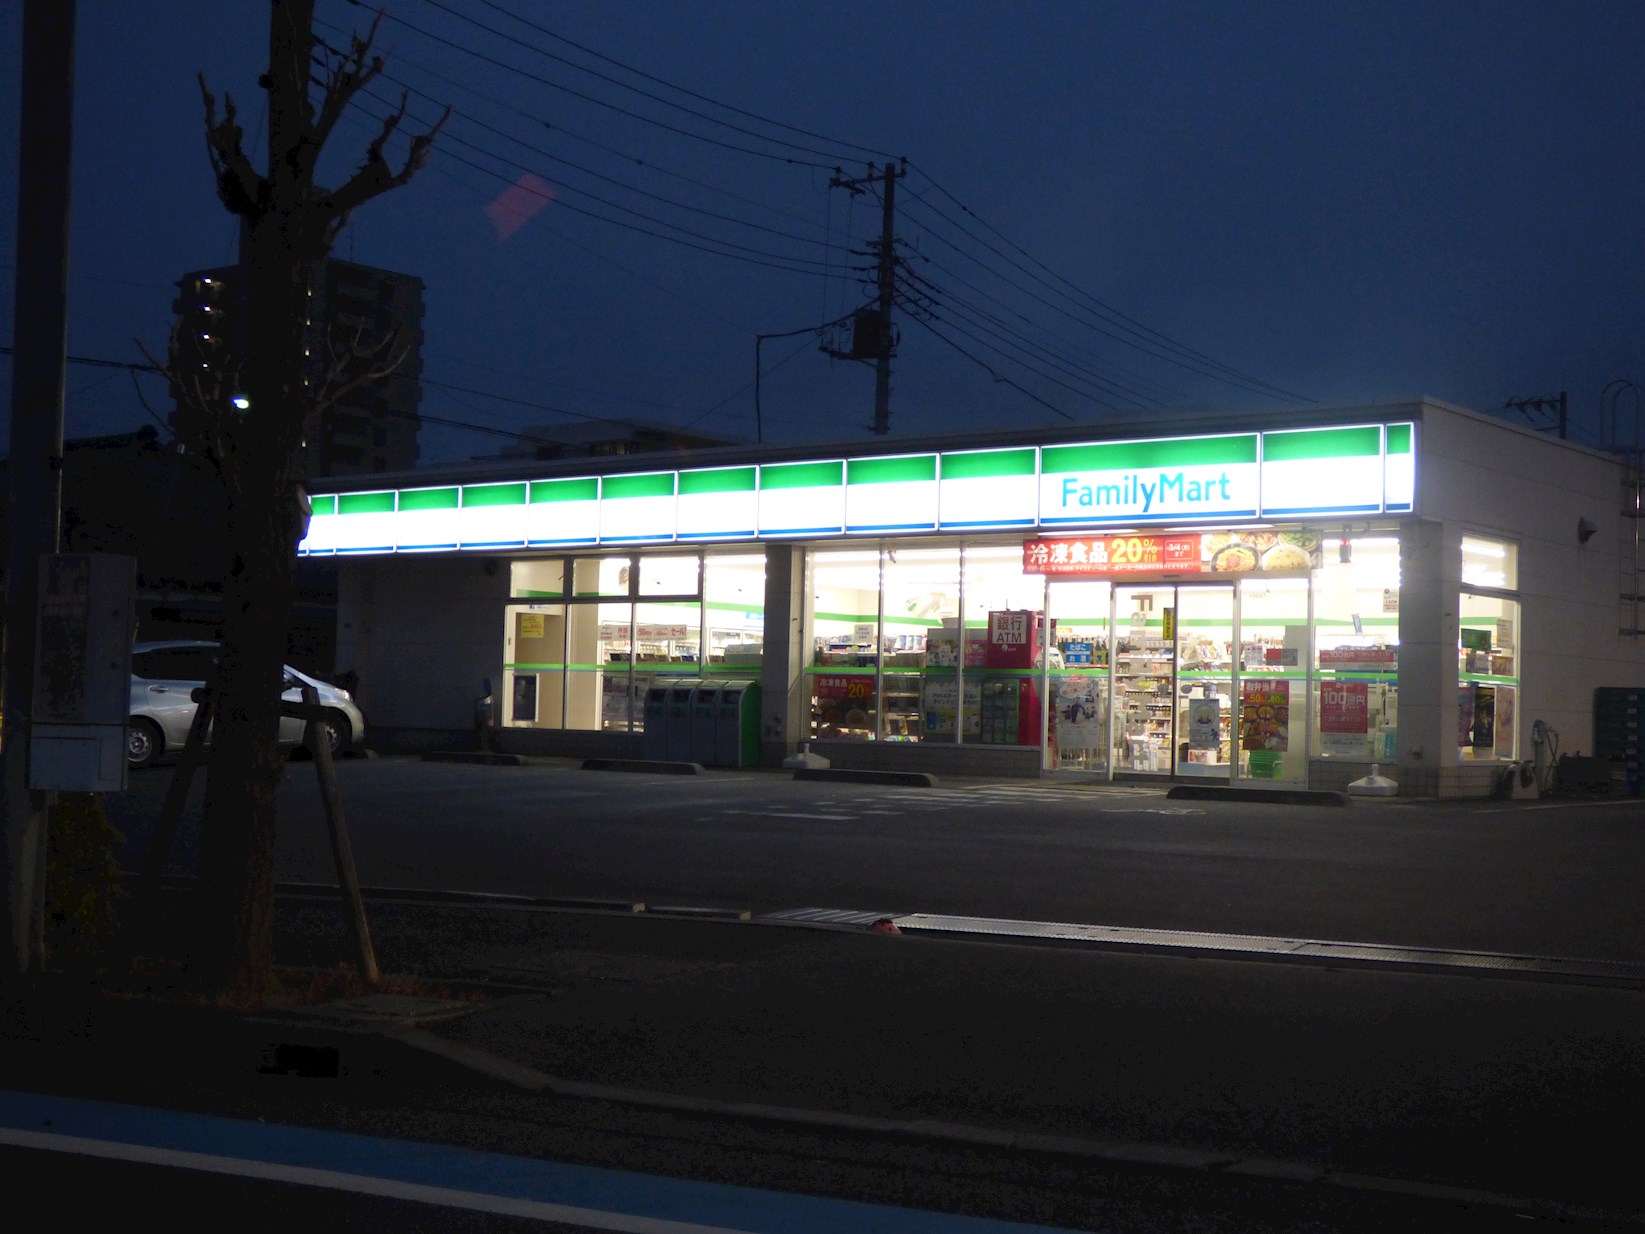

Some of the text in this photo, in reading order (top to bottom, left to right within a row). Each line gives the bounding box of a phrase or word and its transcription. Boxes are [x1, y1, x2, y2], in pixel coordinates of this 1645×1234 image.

[1062, 472, 1231, 513] FamilyMart
[1030, 541, 1108, 565] 冷凍食品
[997, 616, 1023, 631] 銀行
[997, 632, 1022, 643] ATM
